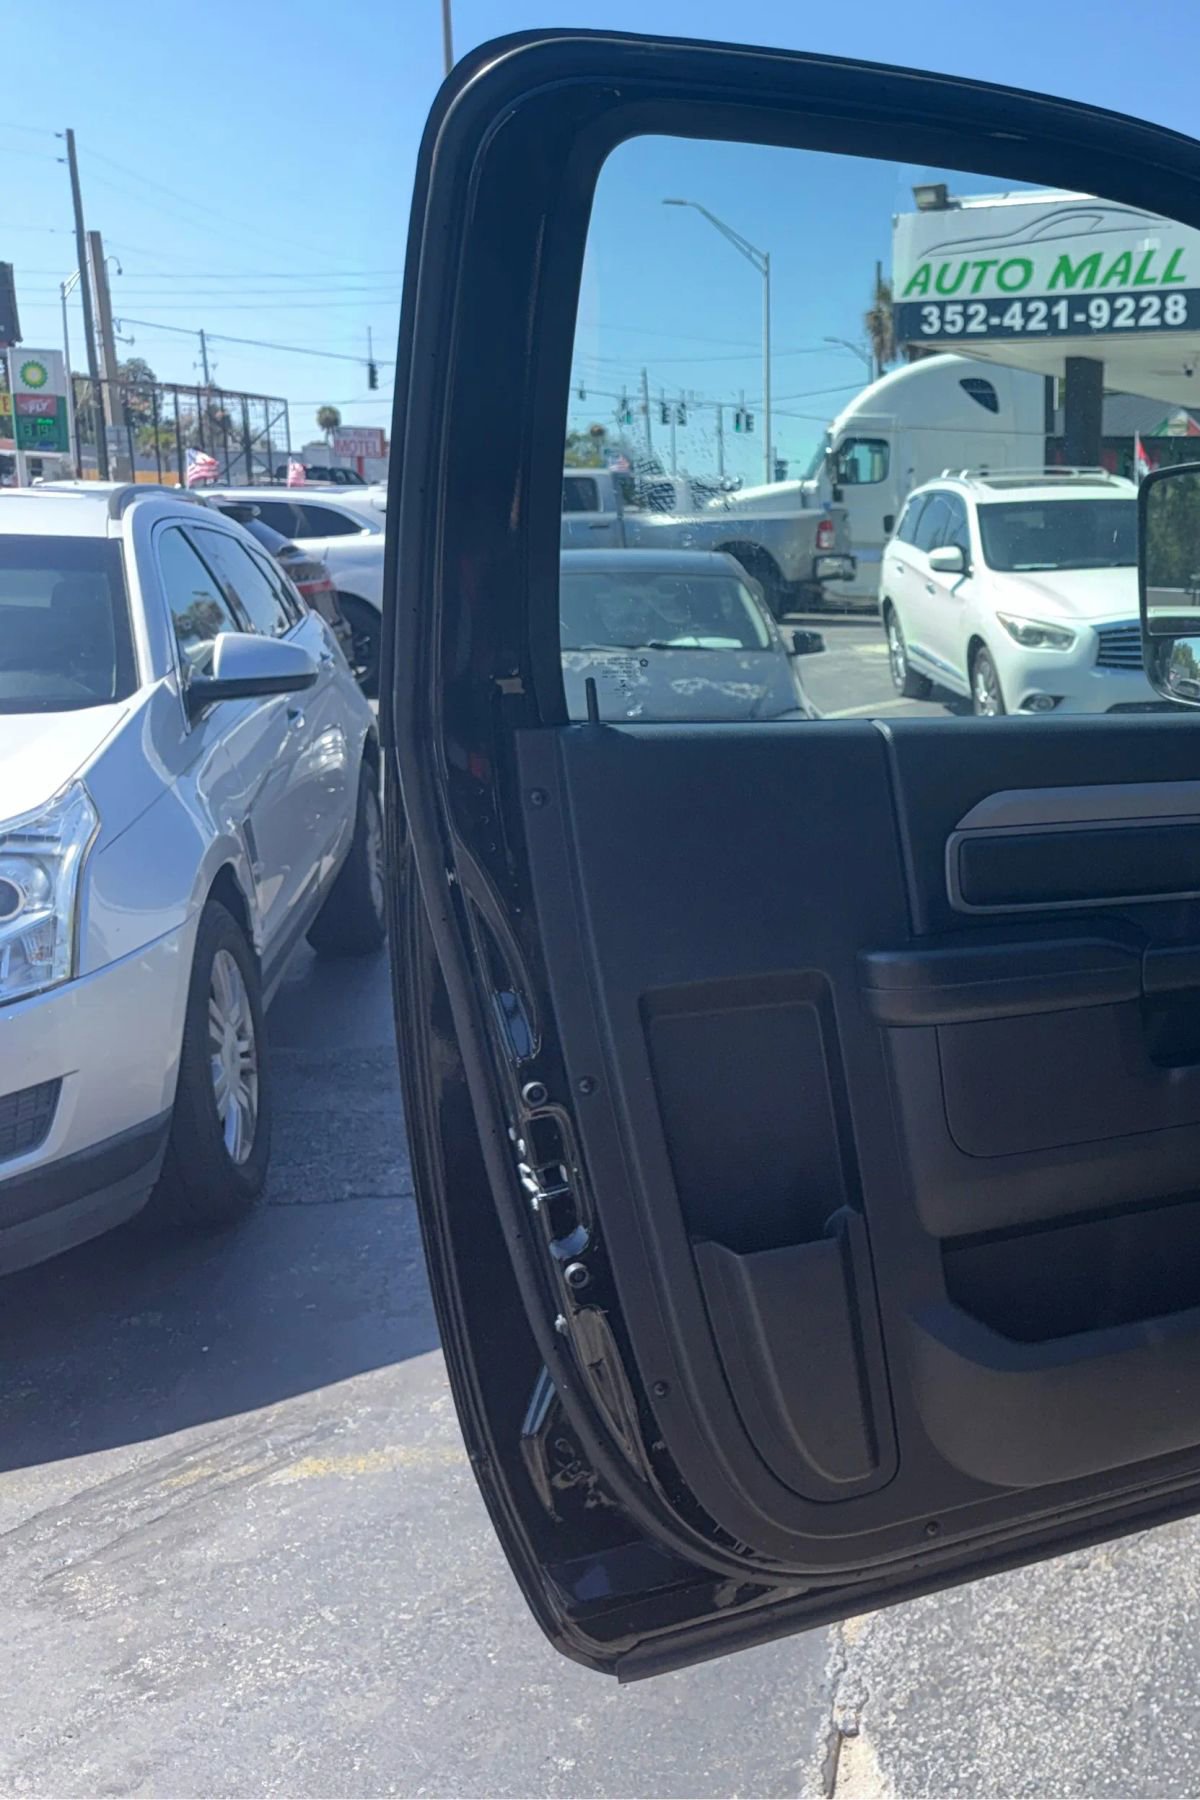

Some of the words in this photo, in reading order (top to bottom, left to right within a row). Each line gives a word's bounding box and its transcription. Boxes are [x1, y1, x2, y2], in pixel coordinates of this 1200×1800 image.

[901, 257, 1035, 298] AUTO
[1047, 247, 1187, 291] MALL
[920, 293, 1189, 336] 352-421-9228
[335, 440, 377, 455] MOTEL
